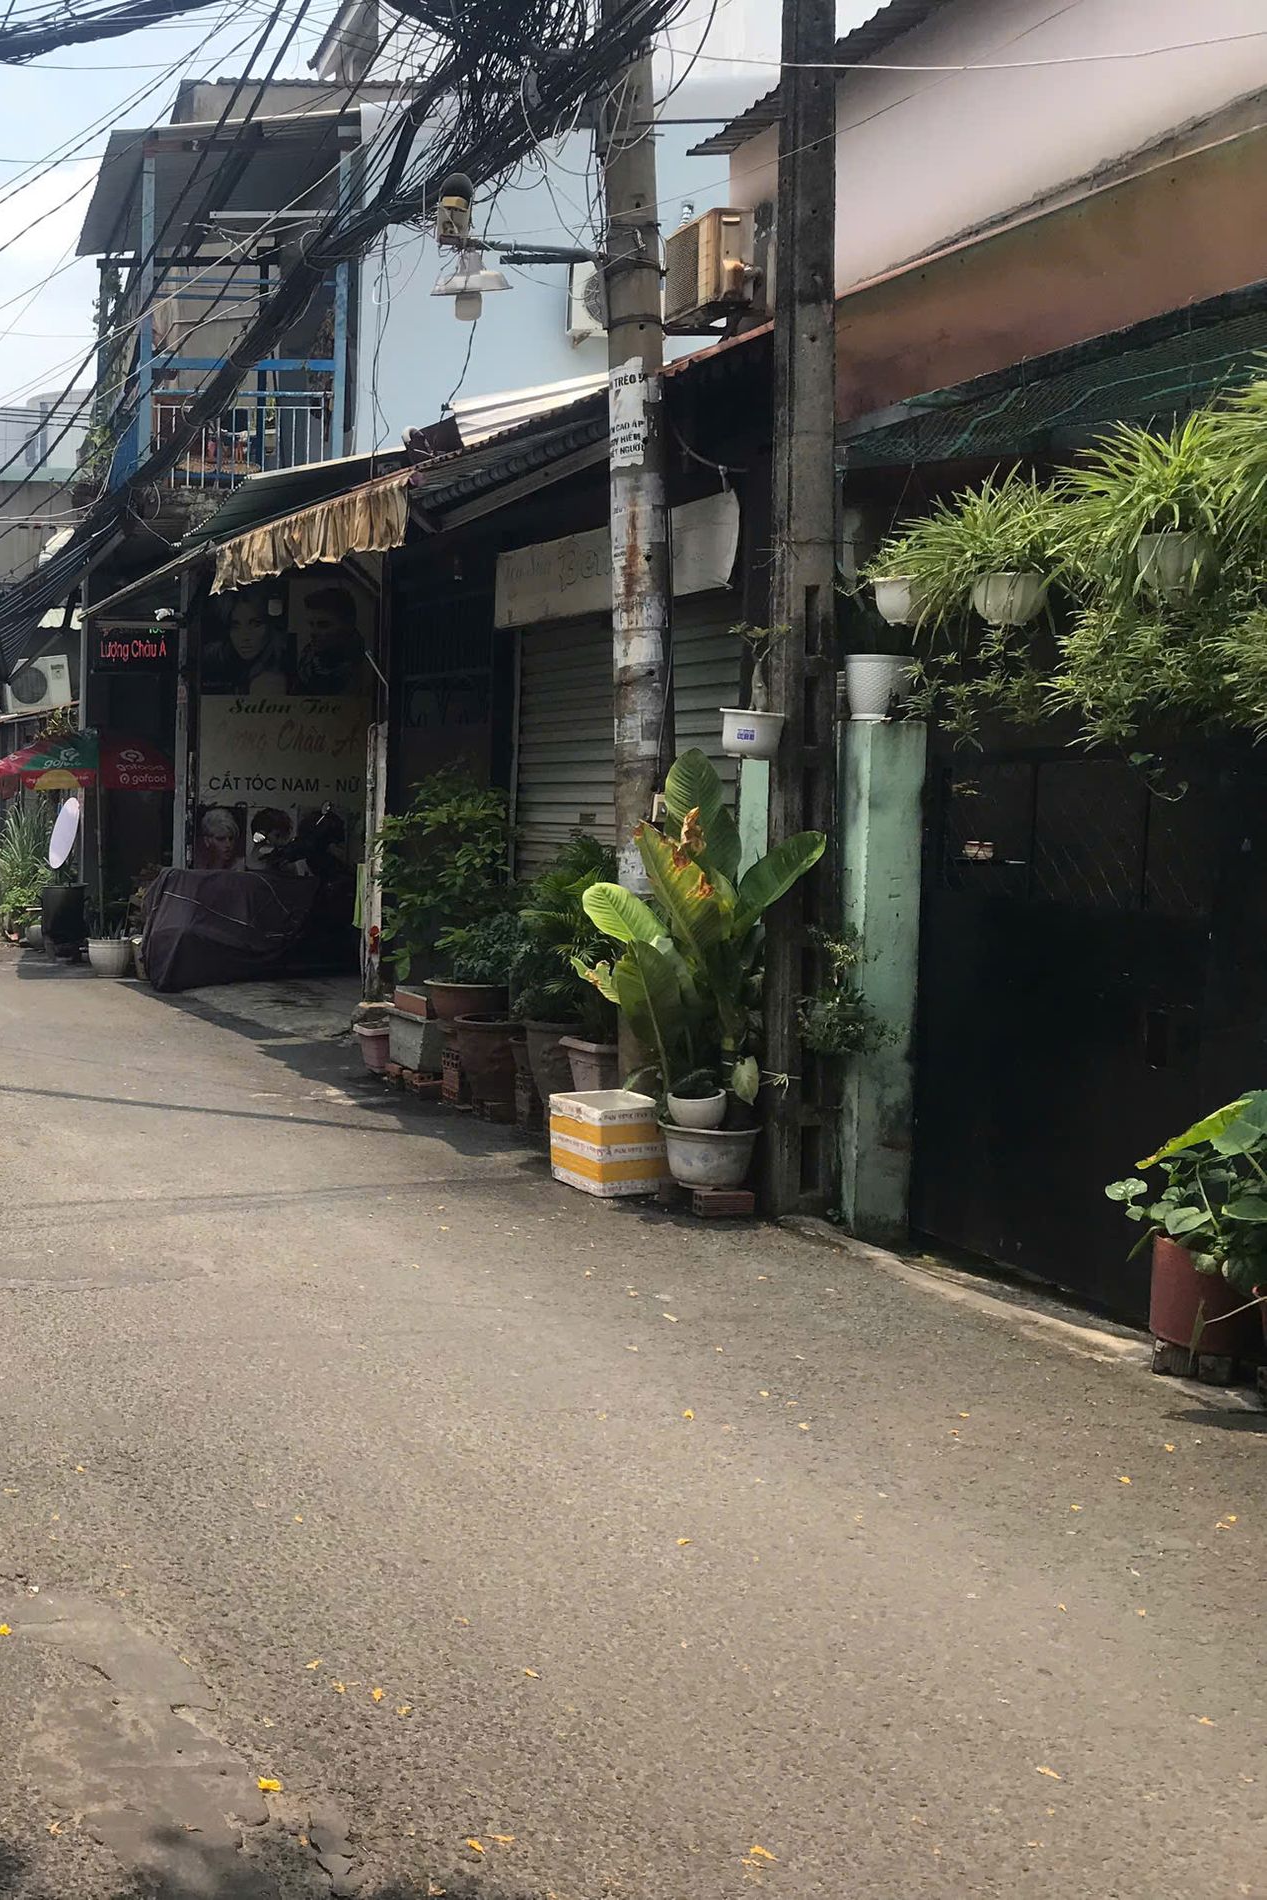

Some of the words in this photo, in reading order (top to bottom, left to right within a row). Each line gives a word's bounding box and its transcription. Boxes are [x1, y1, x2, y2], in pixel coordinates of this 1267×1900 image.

[209, 770, 241, 791] CẮT
[244, 774, 277, 791] TÓC
[281, 777, 320, 792] NAM
